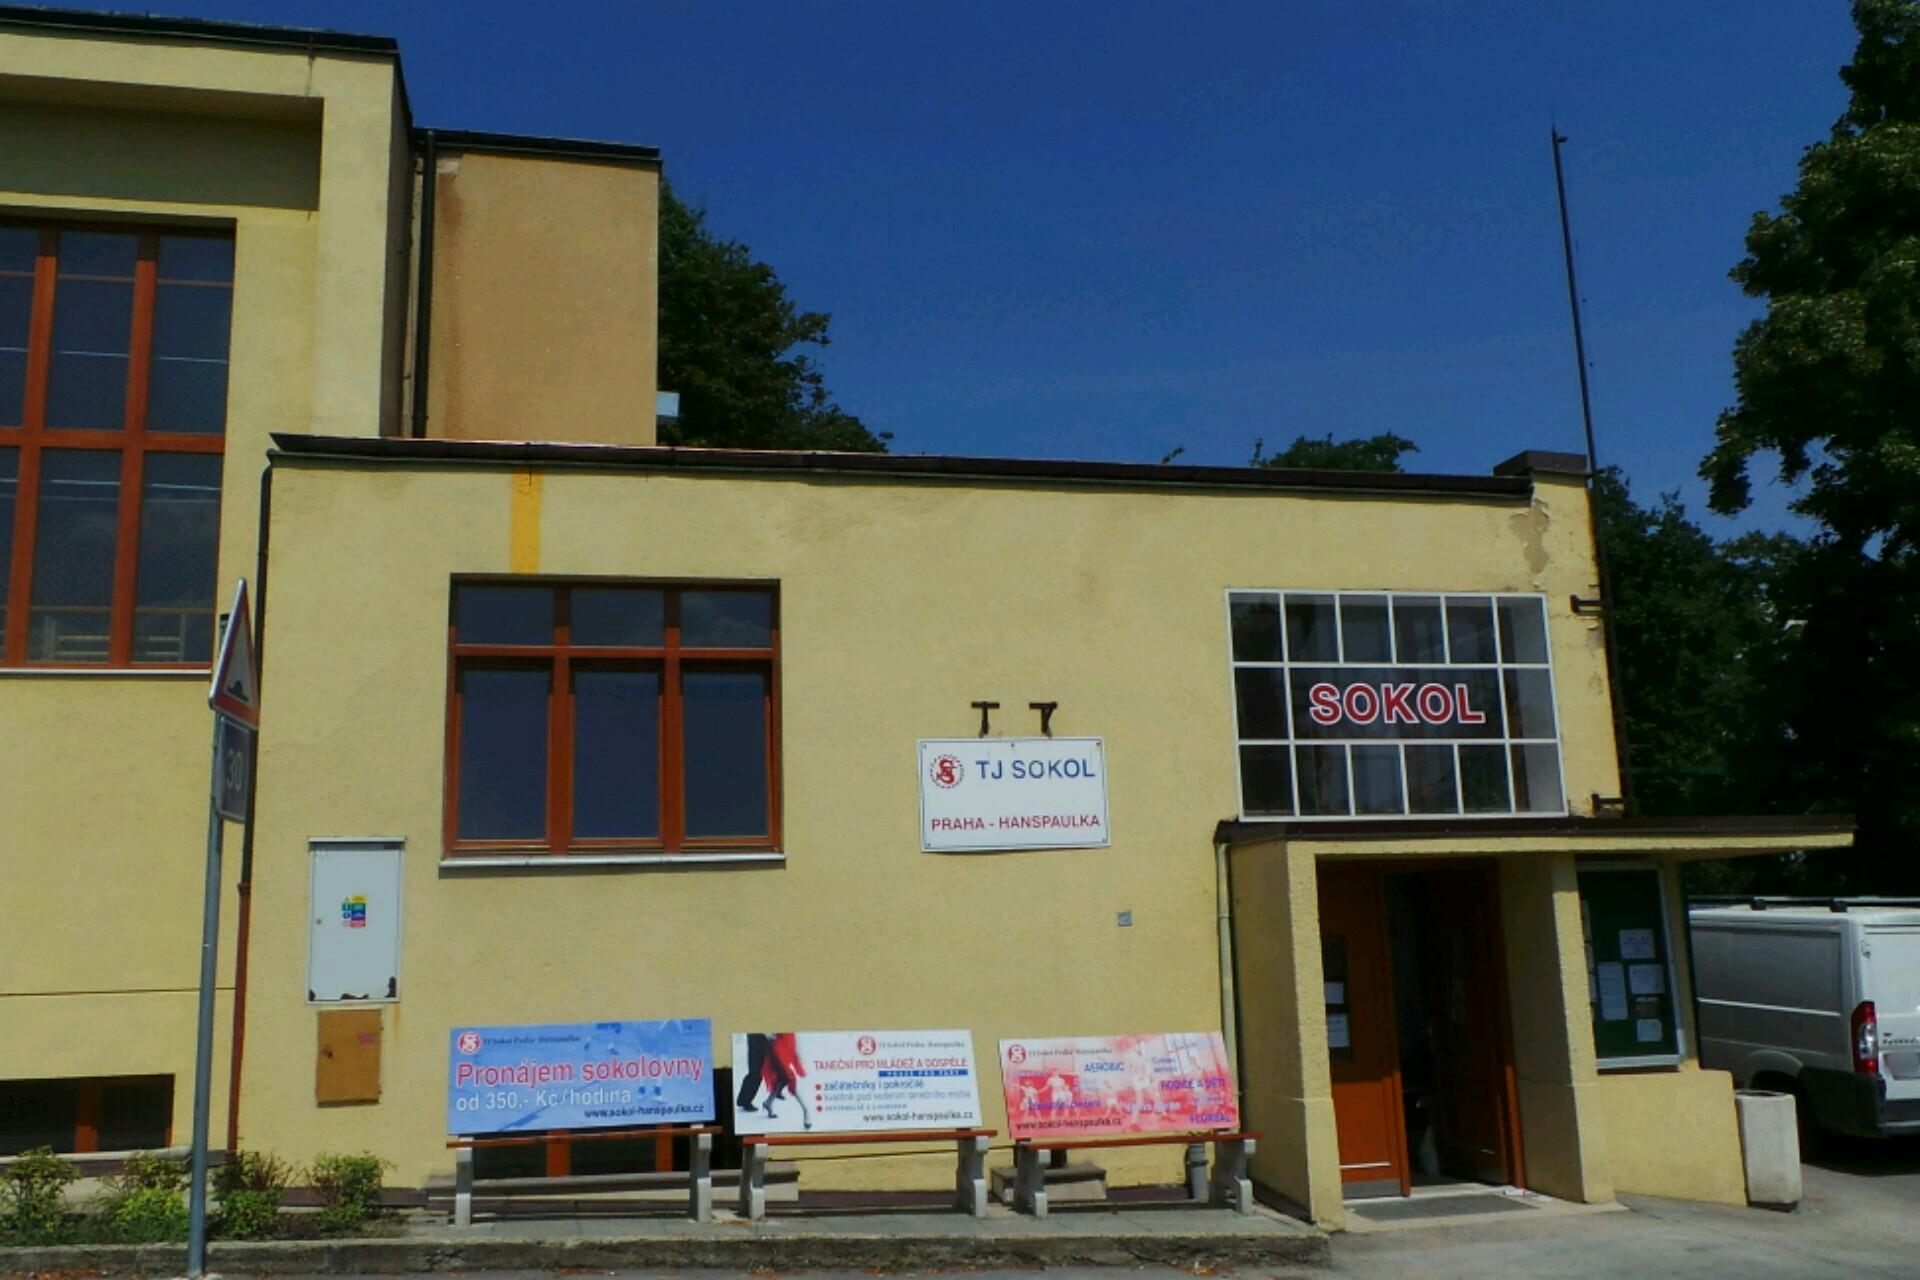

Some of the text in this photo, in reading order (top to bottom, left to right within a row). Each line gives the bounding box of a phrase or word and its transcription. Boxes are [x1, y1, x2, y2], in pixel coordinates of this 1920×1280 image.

[1309, 683, 1486, 726] SOKOL
[227, 747, 244, 792] 30
[976, 758, 1096, 779] TJ SOKOL
[931, 817, 985, 831] PRAHA
[999, 815, 1101, 829] HANSPAULKA
[457, 1055, 703, 1089] Pronájem sokolovny
[456, 1092, 479, 1111] od
